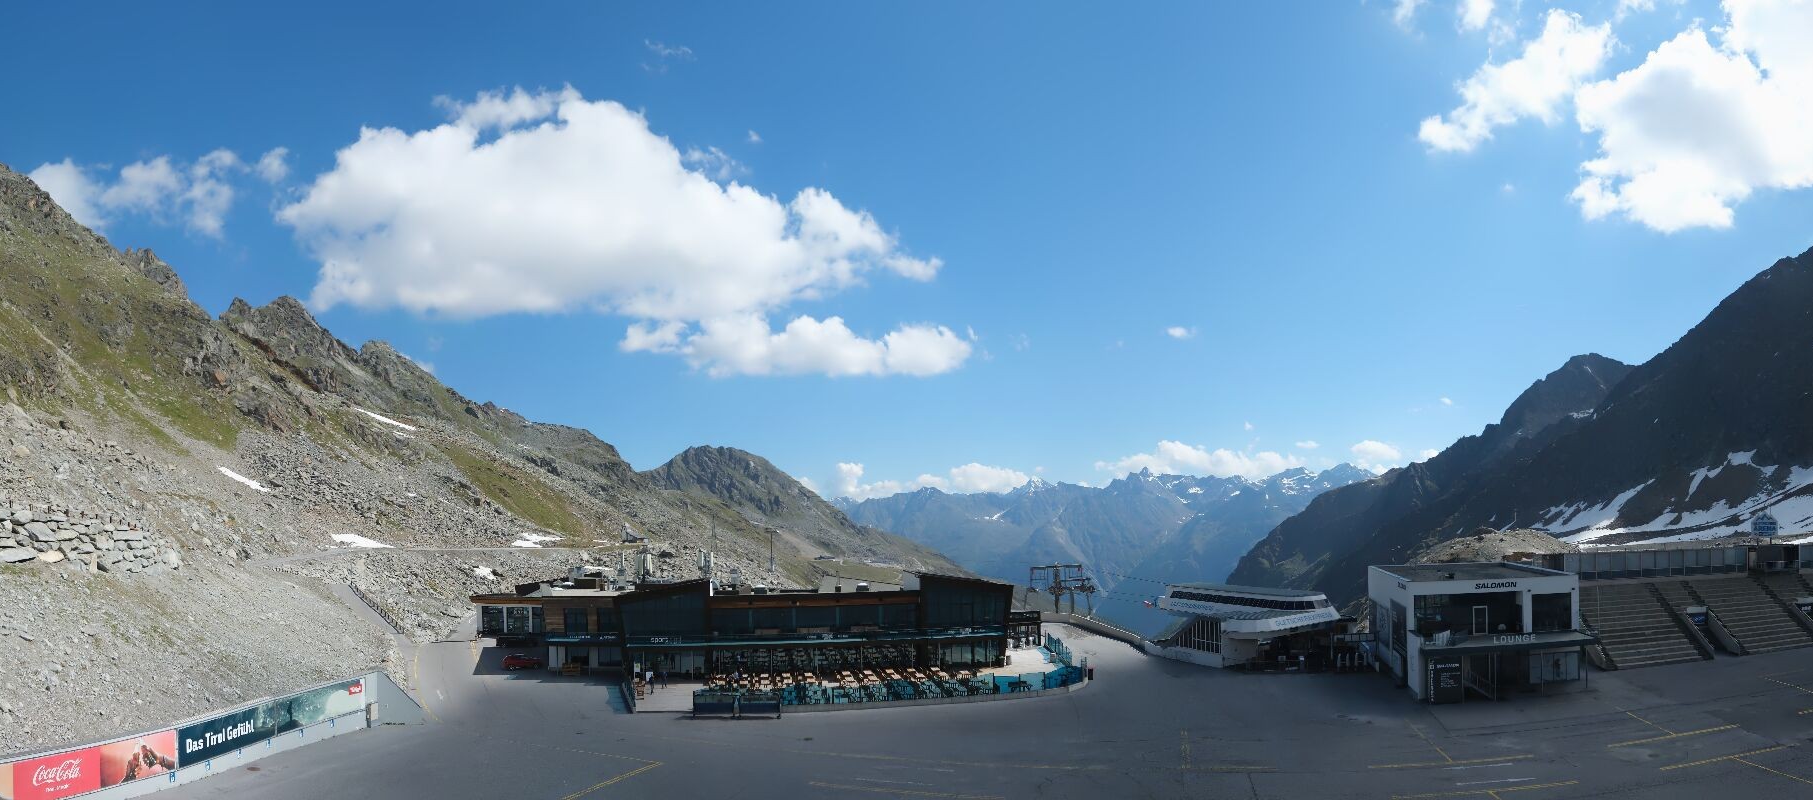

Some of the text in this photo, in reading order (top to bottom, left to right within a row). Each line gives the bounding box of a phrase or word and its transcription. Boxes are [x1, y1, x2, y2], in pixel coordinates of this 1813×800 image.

[1475, 581, 1517, 590] SALOMON
[1493, 634, 1536, 644] LOUNGE
[186, 719, 254, 753] Das Tirol Gefühl
